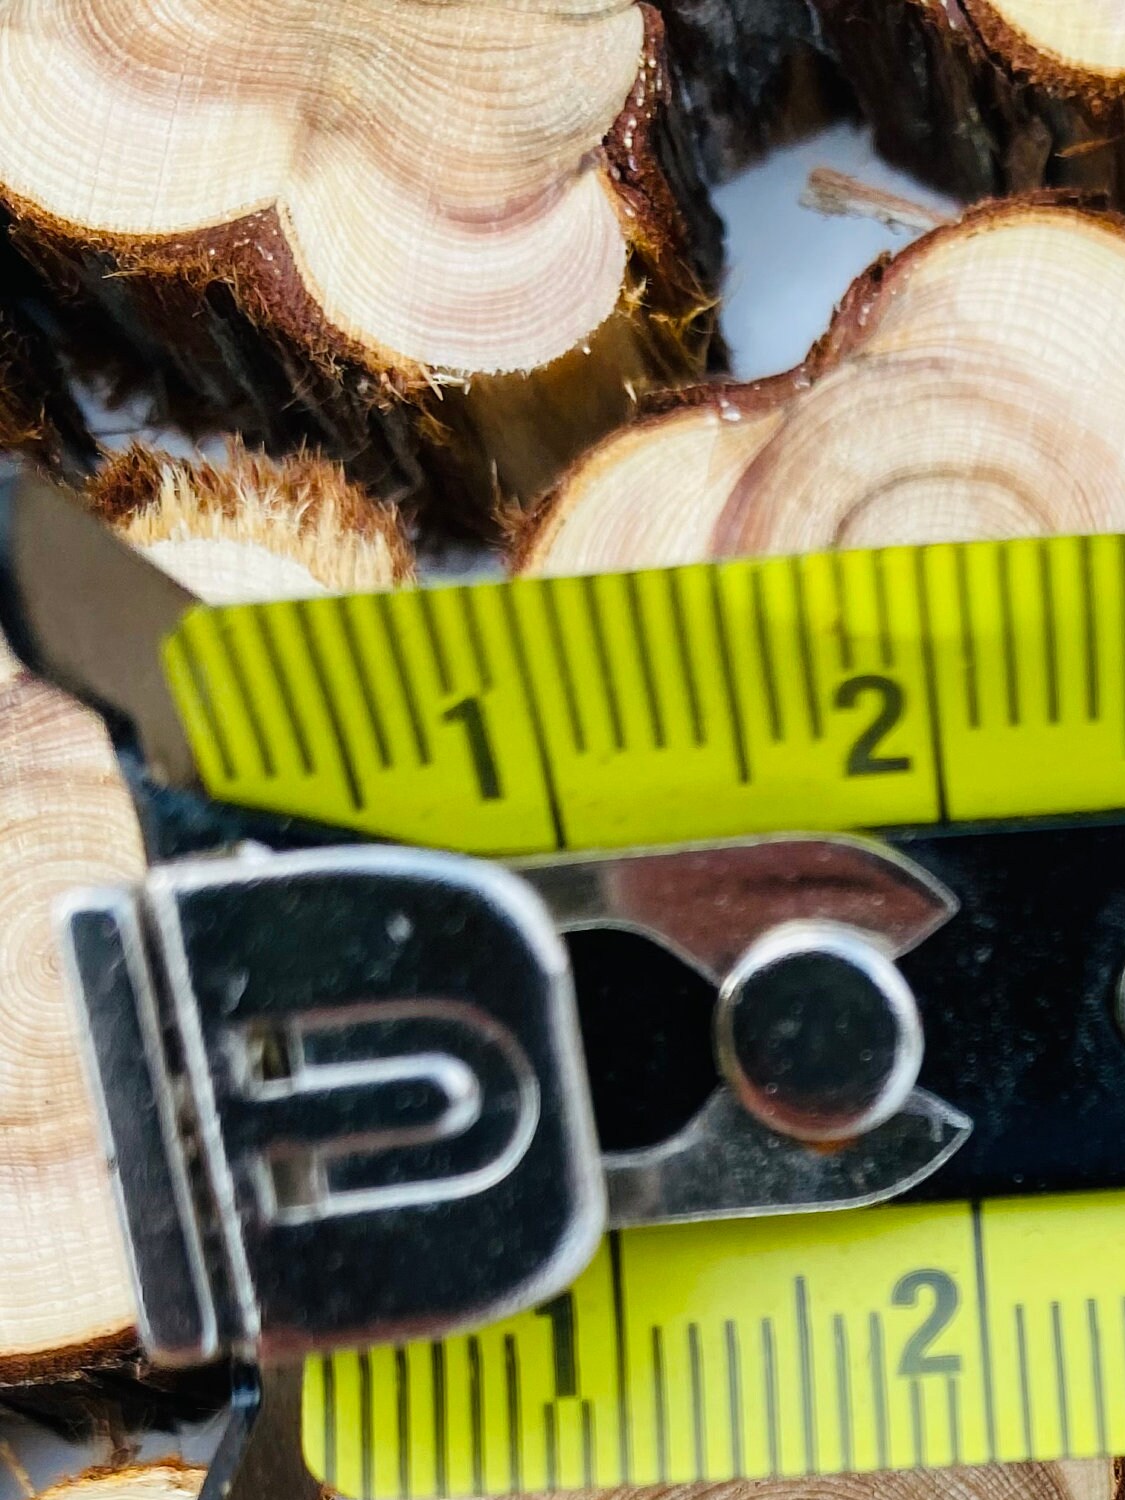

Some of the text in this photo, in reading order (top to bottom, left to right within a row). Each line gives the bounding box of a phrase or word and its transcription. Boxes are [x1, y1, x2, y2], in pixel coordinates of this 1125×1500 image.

[440, 696, 503, 800] 1
[834, 674, 912, 778] 2
[534, 1288, 578, 1397] 1
[891, 1268, 964, 1377] 2
